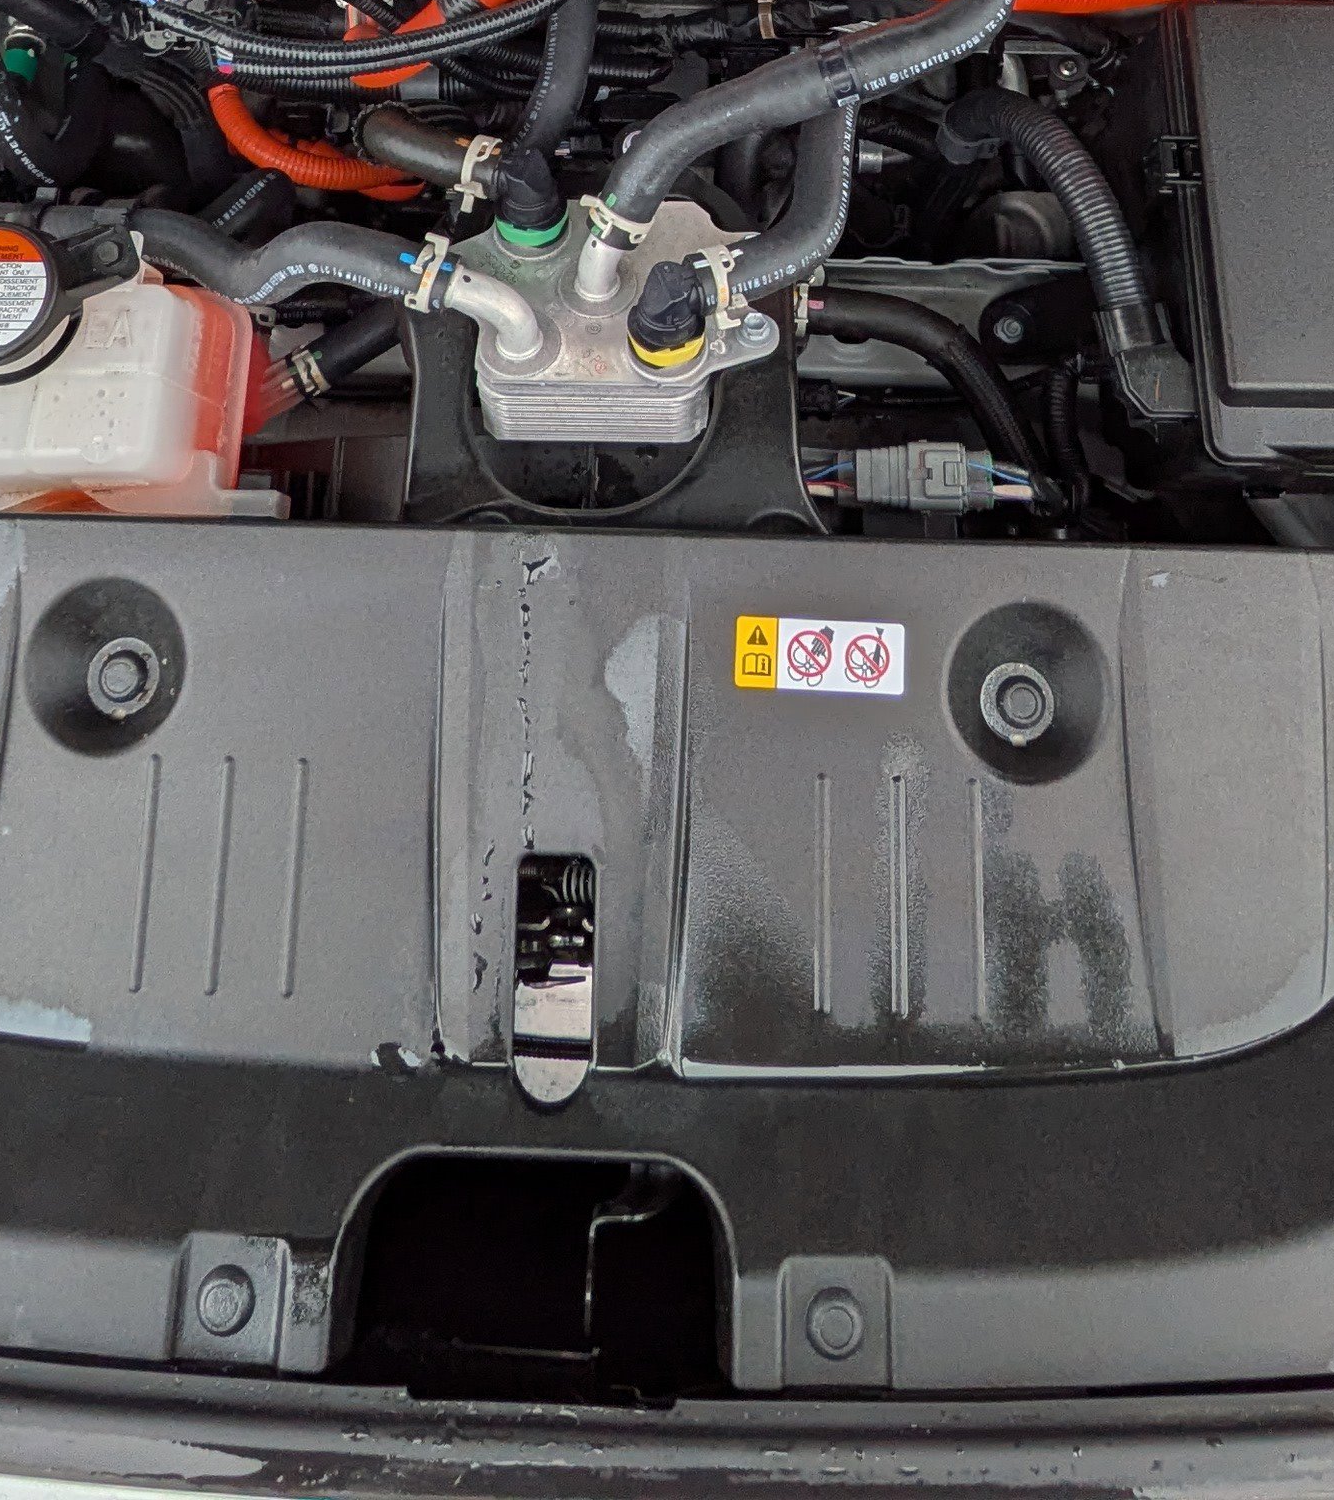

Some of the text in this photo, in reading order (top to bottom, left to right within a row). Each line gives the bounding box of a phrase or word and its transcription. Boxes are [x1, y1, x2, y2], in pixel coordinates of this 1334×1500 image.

[908, 63, 921, 76] TG
[920, 50, 950, 70] WATER
[221, 196, 248, 221] WATER
[730, 276, 761, 294] WATER
